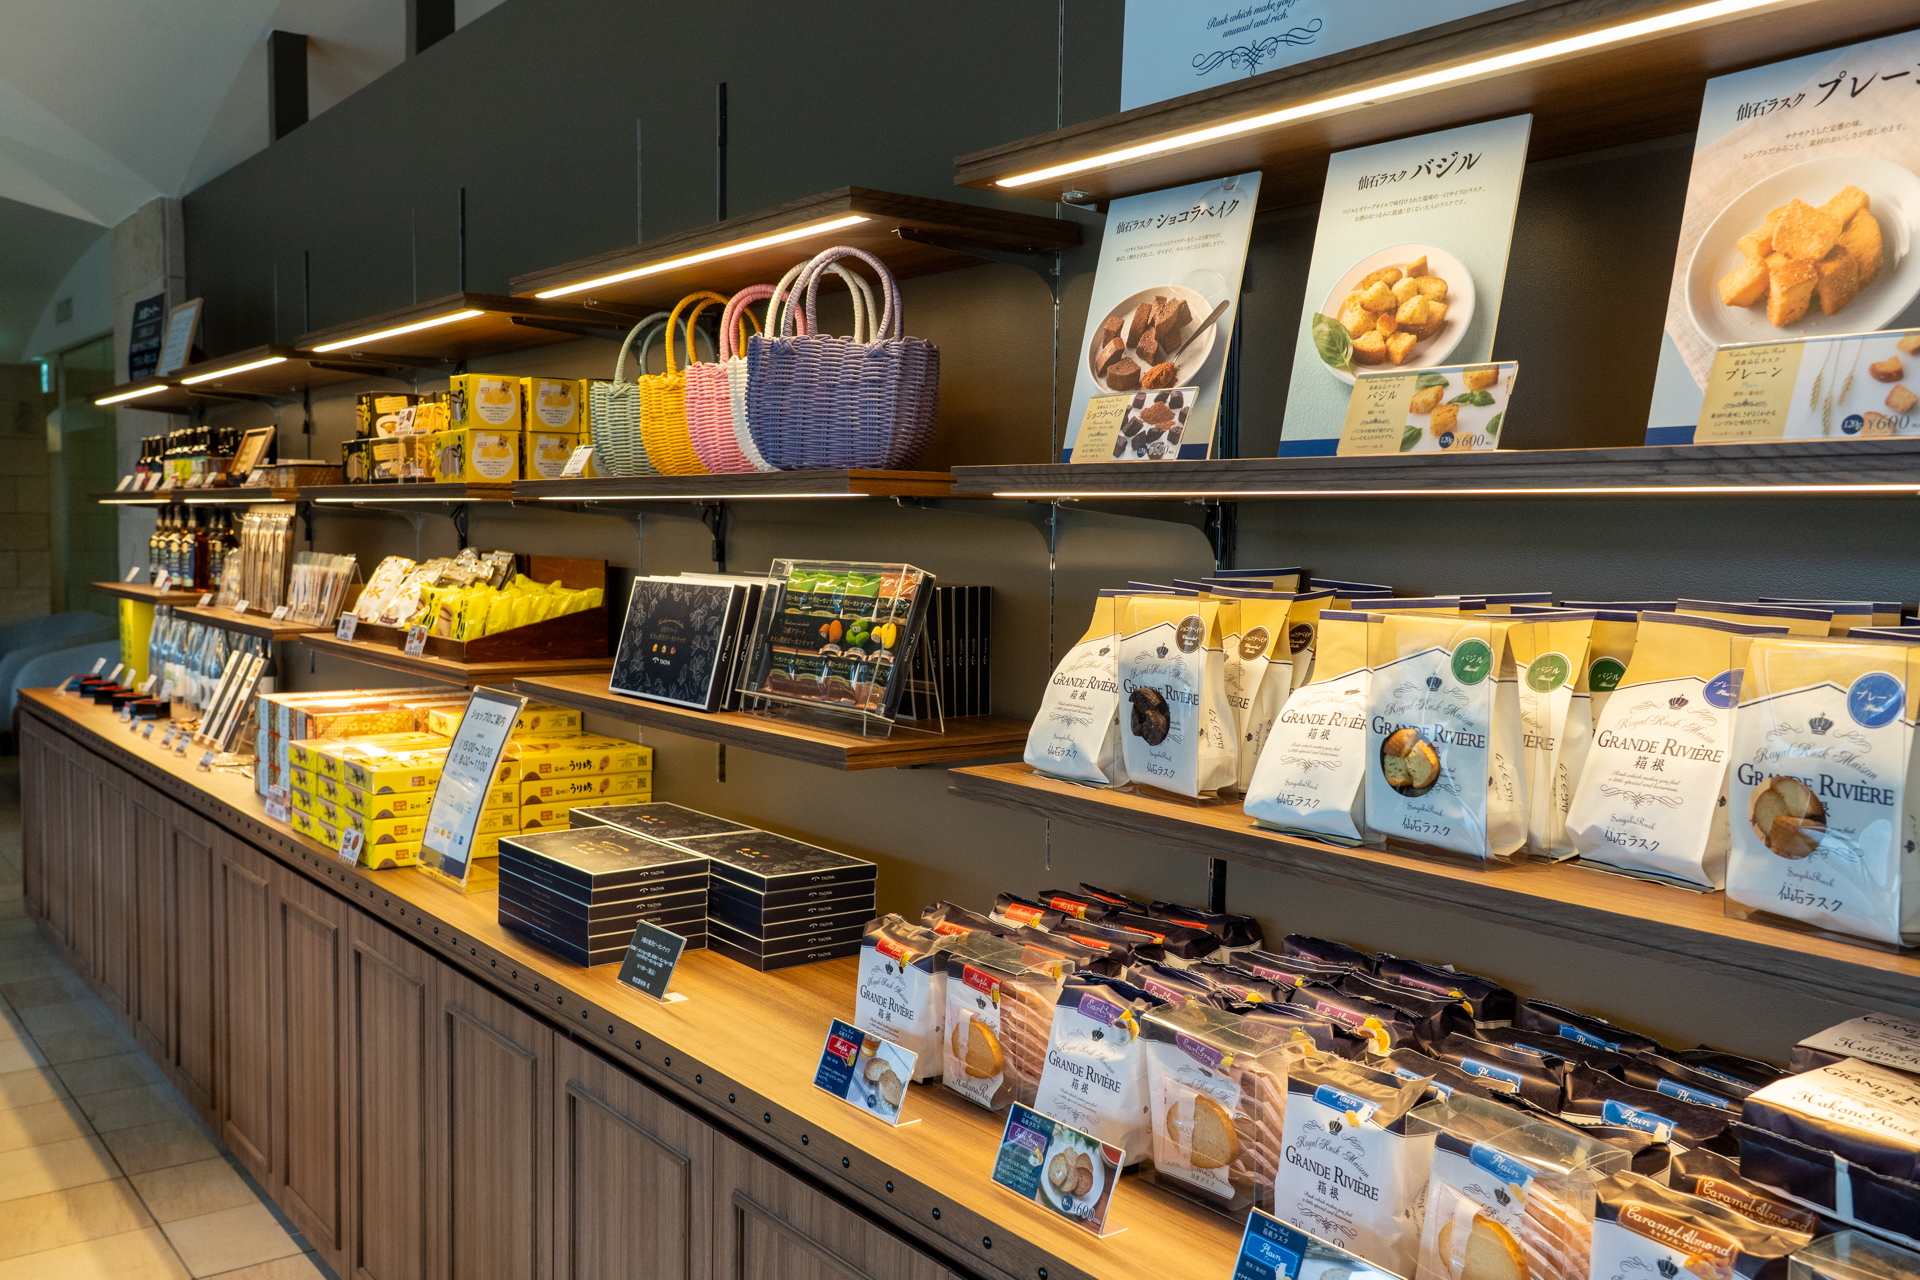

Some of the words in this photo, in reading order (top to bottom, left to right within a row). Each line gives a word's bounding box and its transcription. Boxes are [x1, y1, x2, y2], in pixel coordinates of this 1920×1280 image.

[1206, 13, 1229, 30] Rusk
[1229, 6, 1253, 23] which
[1222, 19, 1254, 38] unusual
[1254, 13, 1272, 29] and
[1270, 8, 1288, 24] rich.
[1736, 93, 1806, 122] 仙石ラスク
[1784, 119, 1864, 142] サクサクとした定番の味。
[1357, 170, 1408, 191] 仙石ラスク
[1409, 151, 1483, 181] バジル
[1116, 218, 1154, 235] 仙石ラスク
[1156, 199, 1240, 229] ショコラベイク
[1725, 366, 1784, 382] プレーン
[1366, 390, 1398, 401] バジル
[1086, 408, 1124, 420] ショコラベイク
[1868, 414, 1911, 430] ¥600
[1843, 419, 1863, 431] 120g
[1440, 434, 1455, 445] 120g
[1456, 434, 1485, 448] ¥600
[1461, 654, 1485, 664] バジル
[1536, 664, 1561, 675] バジル
[1598, 673, 1621, 681] バジル
[1052, 672, 1088, 689] GRANDE
[1714, 681, 1743, 689] プレー
[1165, 684, 1200, 706] RIVIÈRE
[470, 708, 507, 728] ショップのご案内
[1281, 708, 1328, 726] GRANDE
[1384, 700, 1415, 716] Royal
[1415, 697, 1442, 713] Rusk
[1442, 705, 1474, 728] Maison
[1306, 727, 1331, 741] 箱根
[1432, 723, 1486, 749] RIVIÈRE
[1613, 715, 1649, 732] Royal
[1648, 714, 1681, 730] Rusk
[1681, 722, 1716, 744] Maison
[1047, 744, 1078, 759] 仙石ラスク
[1598, 729, 1660, 755] GRANDE
[1660, 737, 1724, 764] RIVIÈRE
[1146, 761, 1176, 779] 仙石ラスク
[1633, 755, 1666, 772] 箱根
[1753, 744, 1792, 764] Royal
[1792, 742, 1832, 761] Rusk
[1832, 750, 1878, 780] Maison
[1612, 769, 1627, 778] Rusk
[1626, 772, 1642, 780] which
[1818, 773, 1895, 807] RIVIÈRE
[1275, 792, 1321, 809] 仙石ラスク
[1402, 815, 1451, 837] 仙石ラスク
[1604, 829, 1660, 852] 仙石ラスク
[1057, 901, 1075, 912] Maple
[1778, 884, 1843, 912] 仙石ラスク
[1016, 908, 1033, 918] Maple
[885, 941, 902, 954] Maple
[970, 972, 988, 990] Maple
[860, 984, 888, 1009] GRANDE
[887, 996, 915, 1021] RIVIÈRE
[1048, 1050, 1084, 1078] GRANDE
[1085, 1065, 1122, 1094] RIVIÈRE
[1822, 1067, 1903, 1097] GRANDE
[952, 1078, 992, 1103] HakoneRus
[1070, 1077, 1089, 1095] 箱根
[1620, 1109, 1651, 1128] Plain
[1296, 1135, 1319, 1151] Royal
[1317, 1138, 1343, 1157] Rusk
[1341, 1150, 1370, 1179] Maison
[1489, 1153, 1520, 1179] Plain
[1285, 1145, 1332, 1181] GRANDE
[1333, 1165, 1380, 1202] RIVIÈRE
[1316, 1180, 1340, 1202] 箱根
[1303, 1190, 1316, 1200] Rusk
[1315, 1195, 1327, 1205] which
[1338, 1206, 1347, 1214] you
[1345, 1208, 1353, 1218] feel
[1262, 1227, 1289, 1244] 箱根ラスク
[1260, 1242, 1282, 1262] Plain
